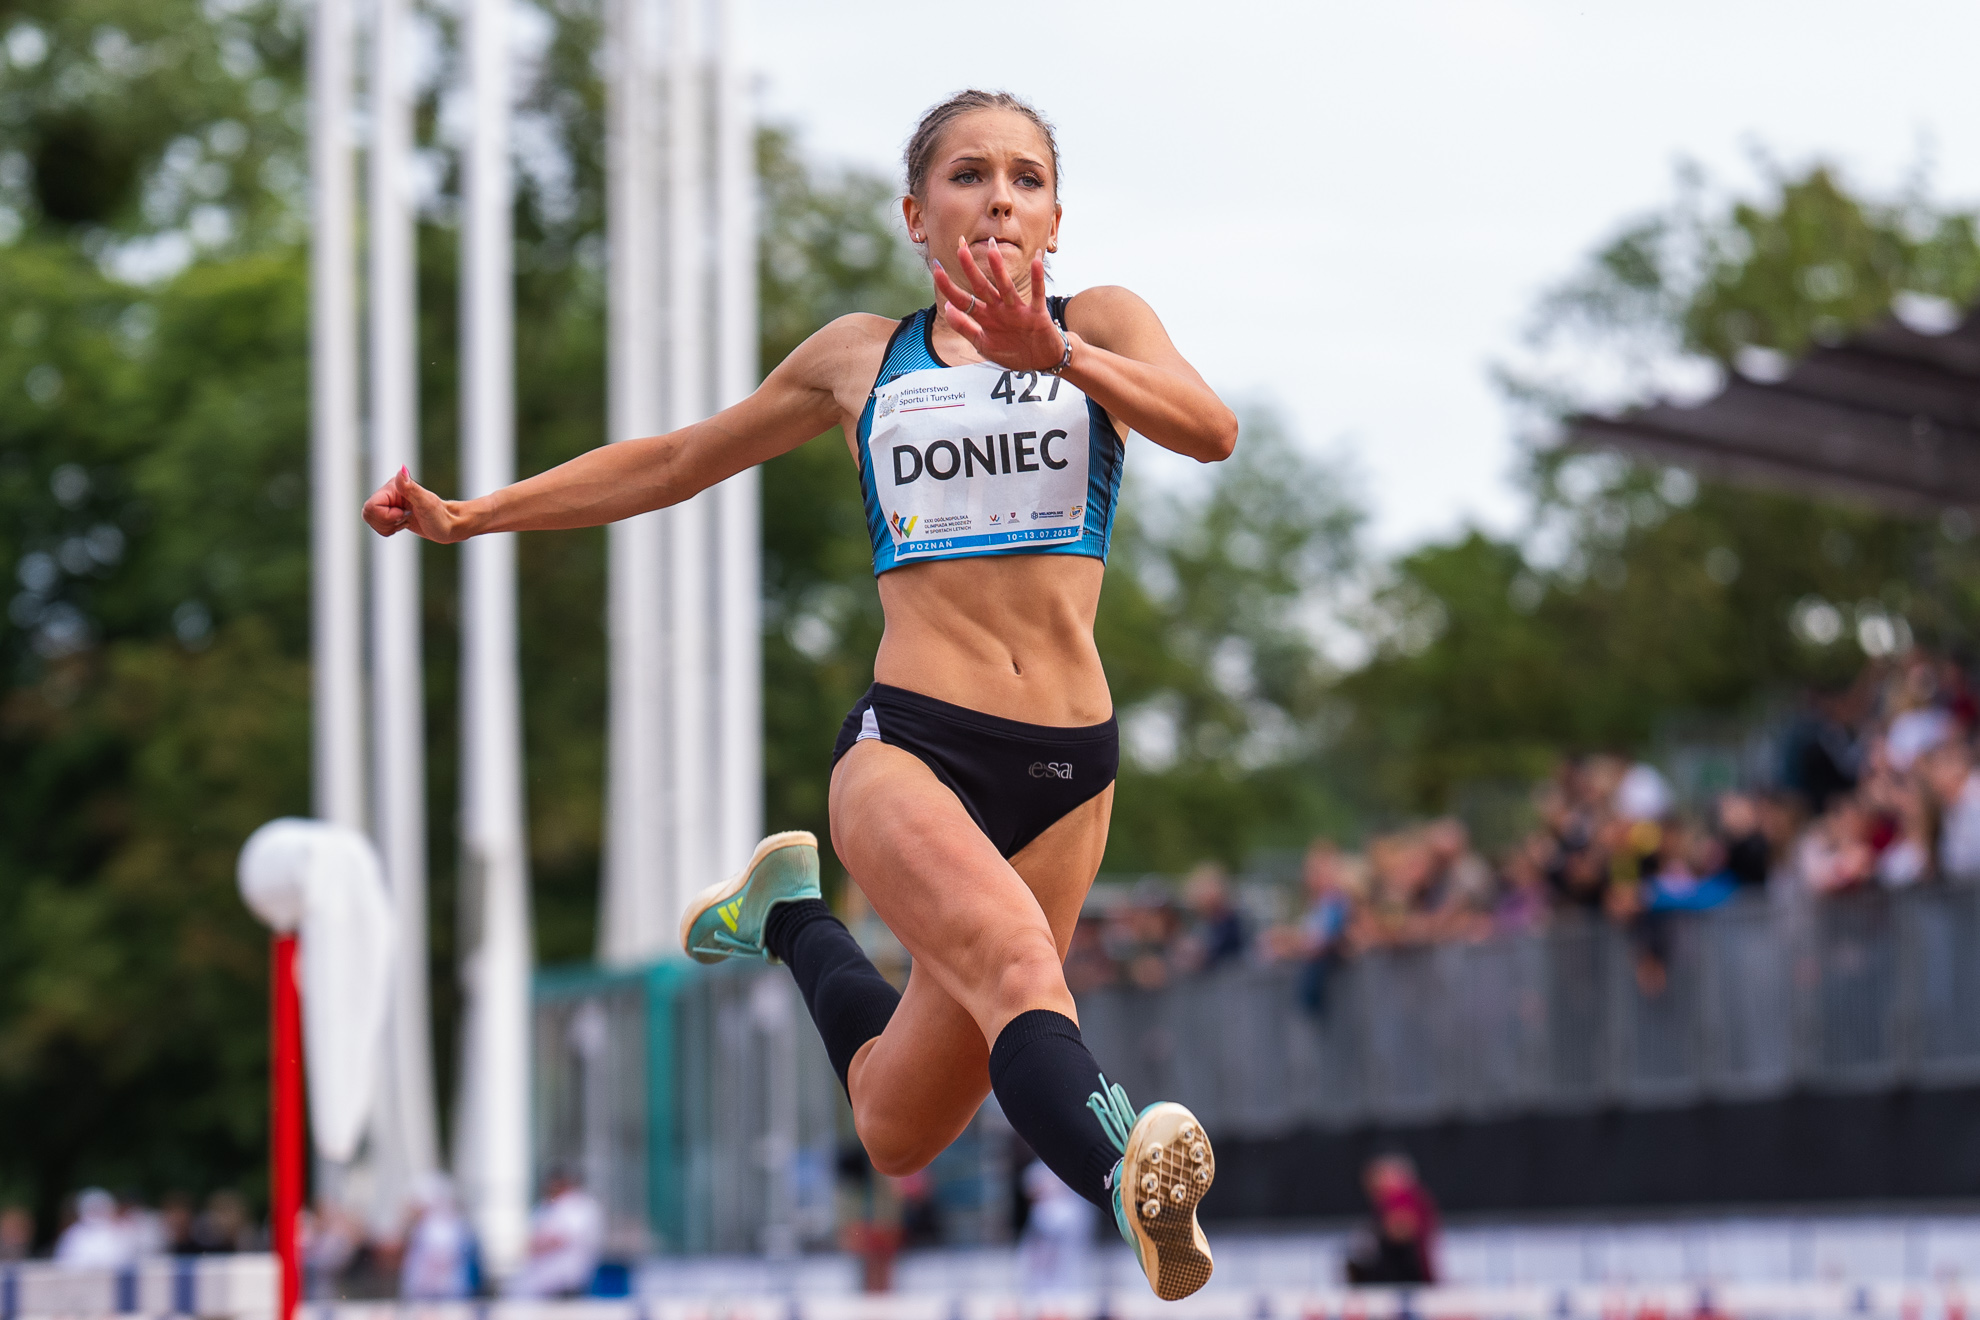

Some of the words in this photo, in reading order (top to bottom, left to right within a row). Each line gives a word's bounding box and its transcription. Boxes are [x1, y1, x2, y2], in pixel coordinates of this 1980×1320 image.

[901, 386, 949, 397] Ministerstwo
[990, 370, 1061, 404] 427
[899, 396, 924, 406] Sportu
[930, 391, 966, 402] Turystyki
[892, 429, 1069, 486] DONIEC
[934, 515, 968, 523] OGÓLNOPOLSKA
[1007, 529, 1071, 541] 10-13.07.2025
[910, 539, 952, 551] POZNAŃ
